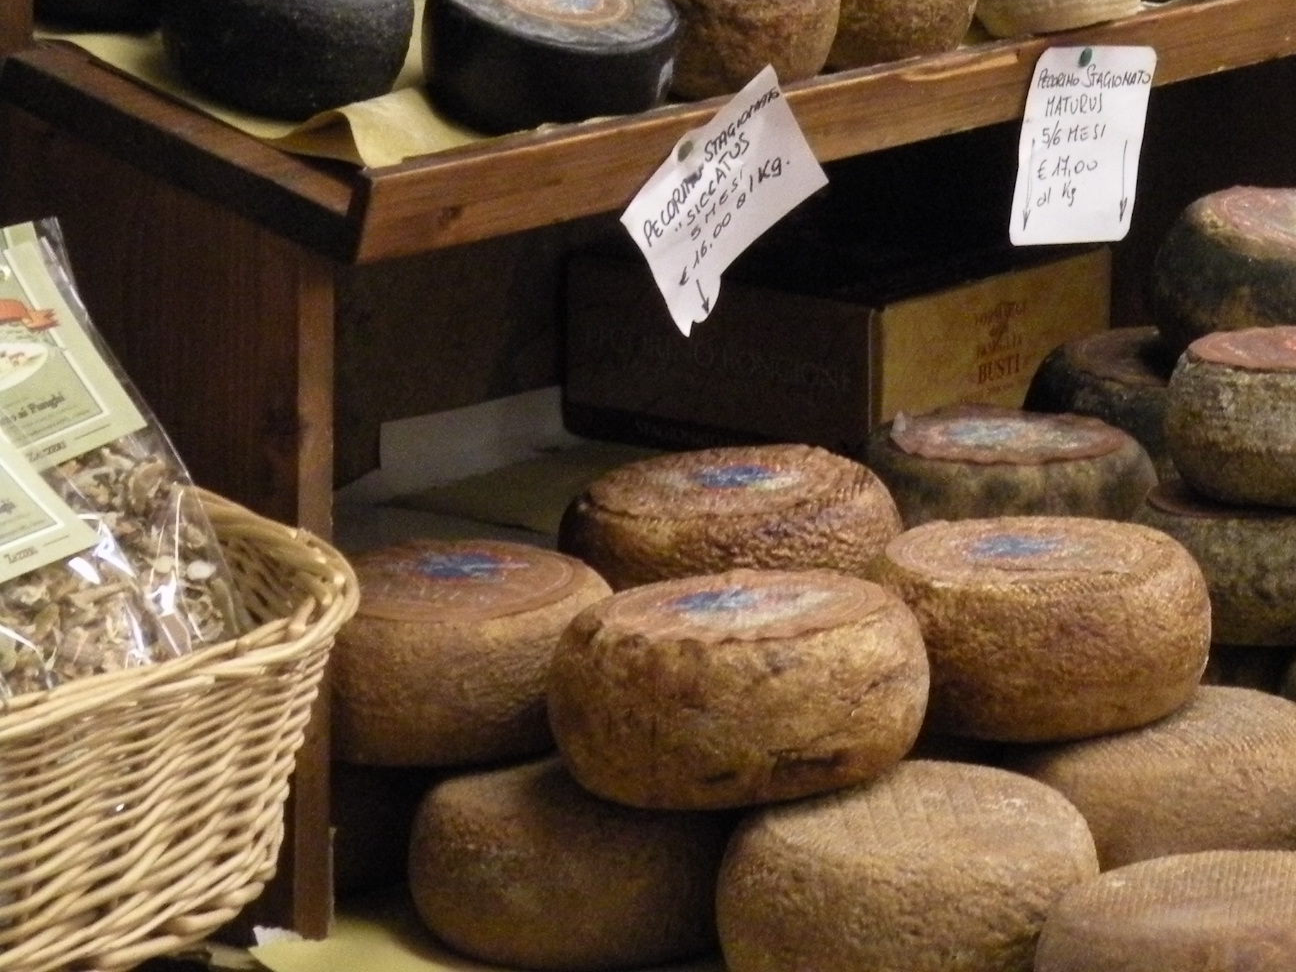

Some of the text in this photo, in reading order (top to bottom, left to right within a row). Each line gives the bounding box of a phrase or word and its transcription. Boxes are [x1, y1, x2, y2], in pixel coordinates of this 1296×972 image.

[1037, 63, 1151, 90] PECORINO STAGIONATO
[1045, 93, 1104, 118] MATURUS
[703, 86, 781, 163] STAGIONATO
[1041, 120, 1107, 148] 5/6 MESI
[704, 168, 744, 225] MESI
[978, 353, 1020, 385] BUSTI
